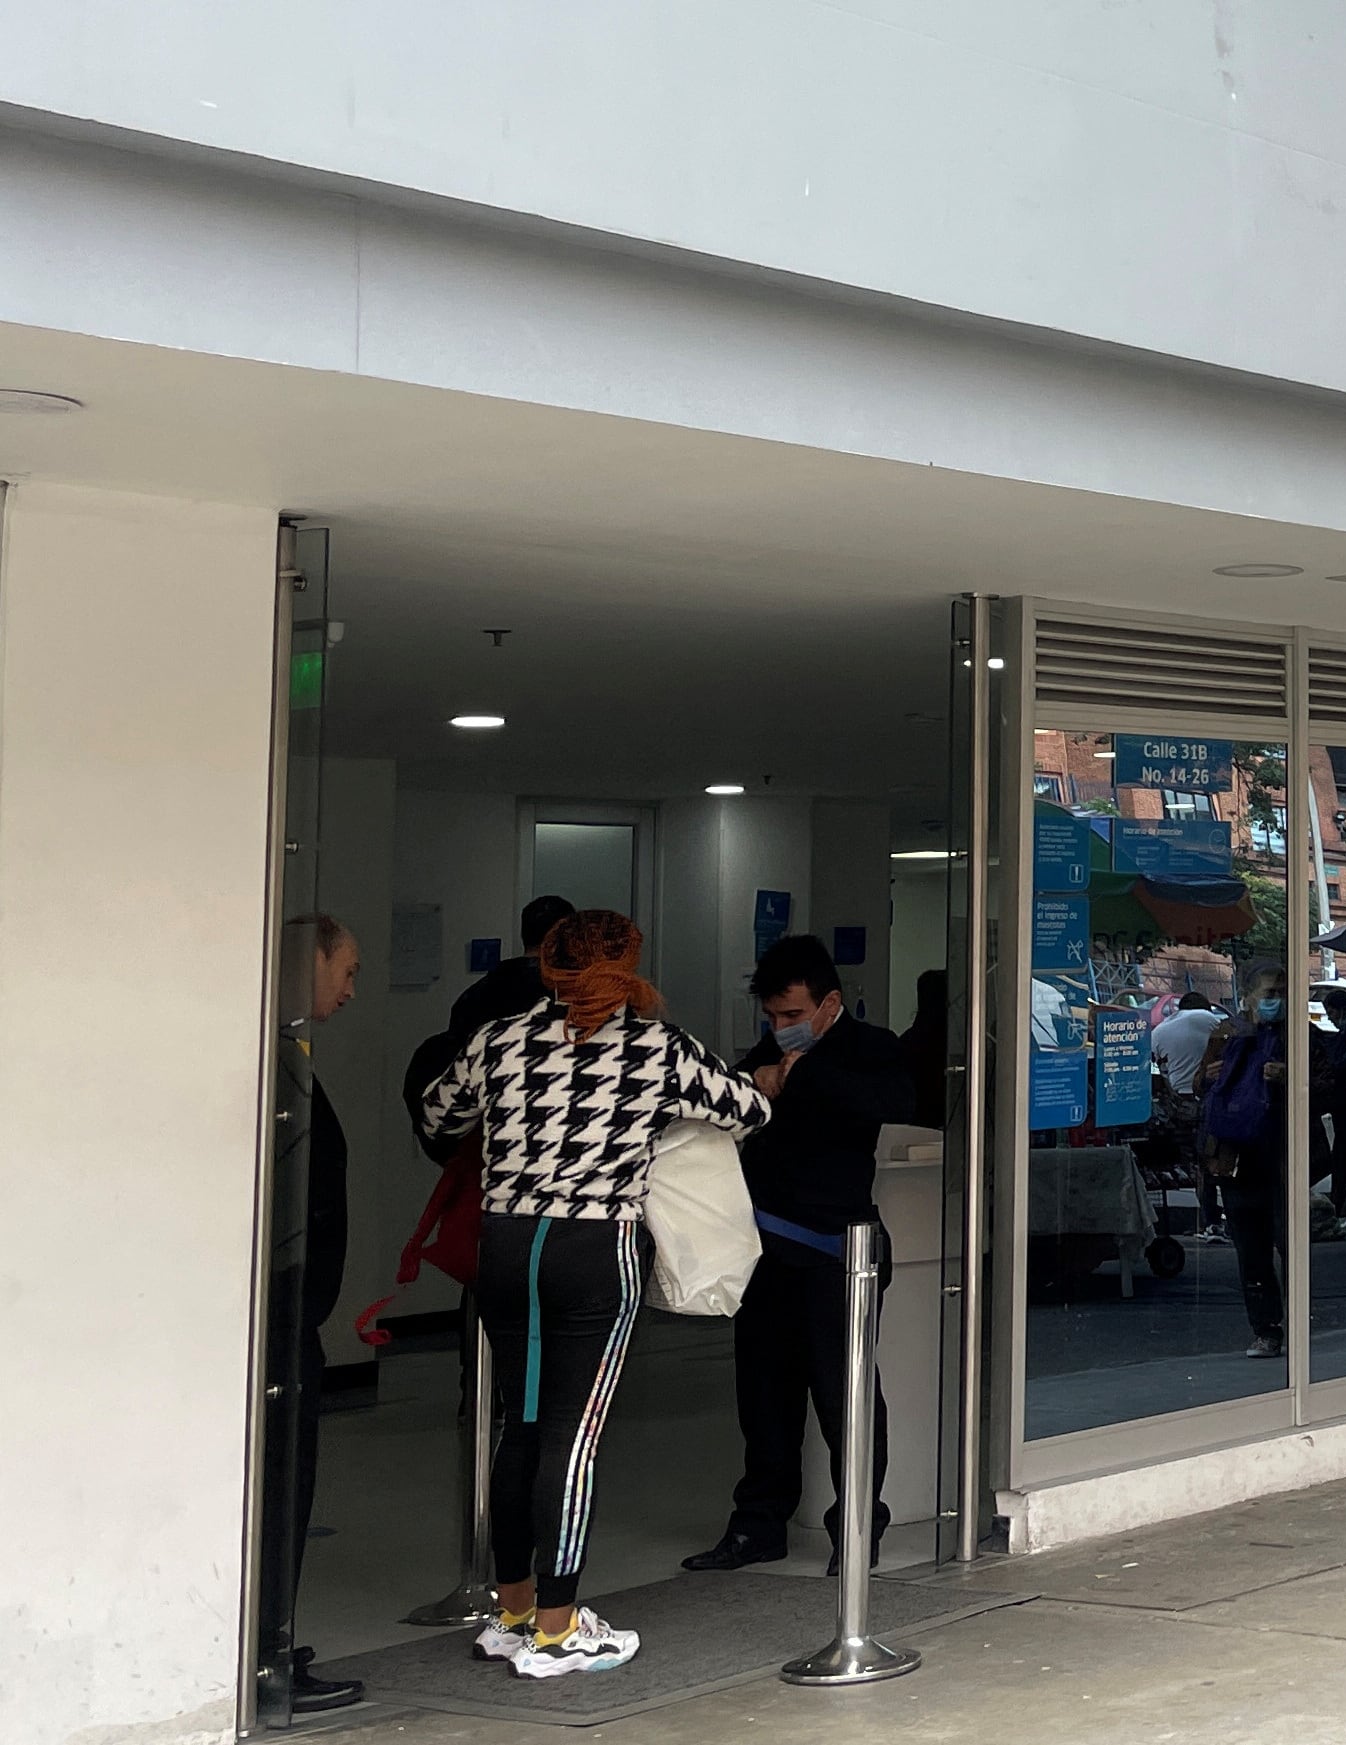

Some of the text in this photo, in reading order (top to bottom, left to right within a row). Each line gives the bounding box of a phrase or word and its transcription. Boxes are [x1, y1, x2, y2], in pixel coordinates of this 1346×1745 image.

[1143, 741, 1208, 760] Calle 31B
[1141, 766, 1209, 784] No. 14-26
[1103, 1019, 1147, 1032] Horario de
[1103, 1031, 1139, 1044] atención
